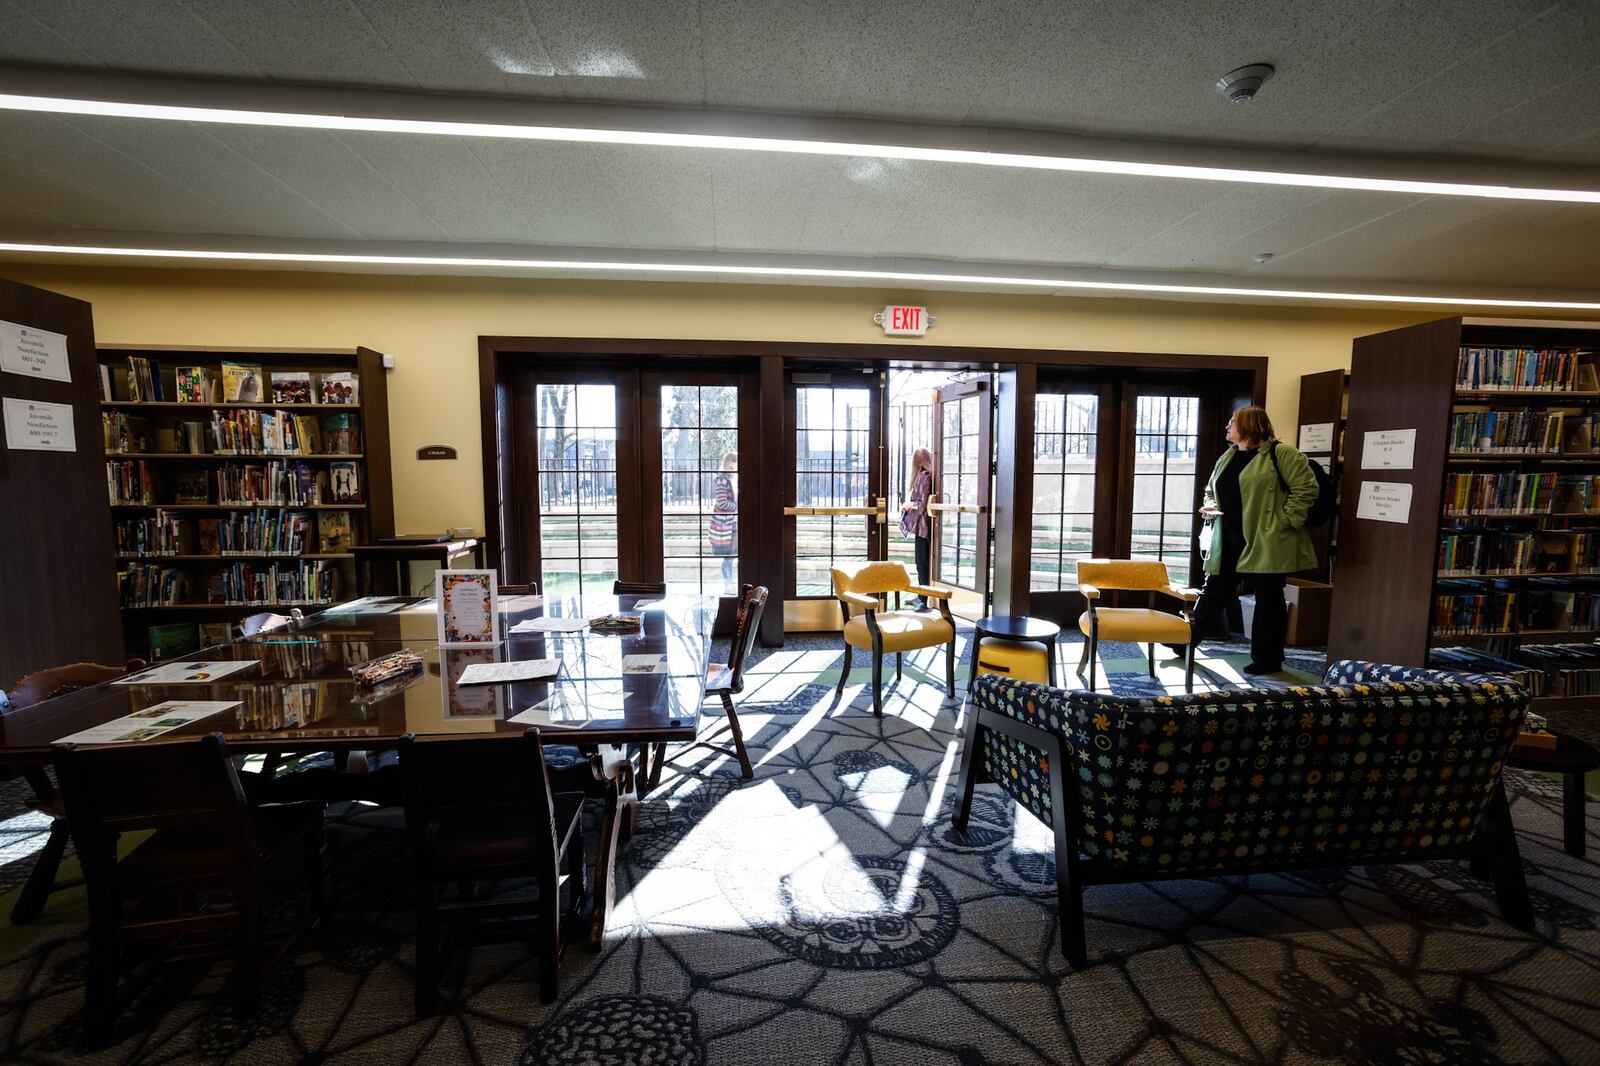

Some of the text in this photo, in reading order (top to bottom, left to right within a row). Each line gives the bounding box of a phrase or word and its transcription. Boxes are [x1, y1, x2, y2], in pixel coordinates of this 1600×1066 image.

[893, 307, 921, 330] EXIT
[20, 338, 45, 348] Juvenile
[17, 345, 49, 357] Nonfiction
[28, 413, 54, 421] Juvenile
[26, 421, 58, 429] Nonfiction
